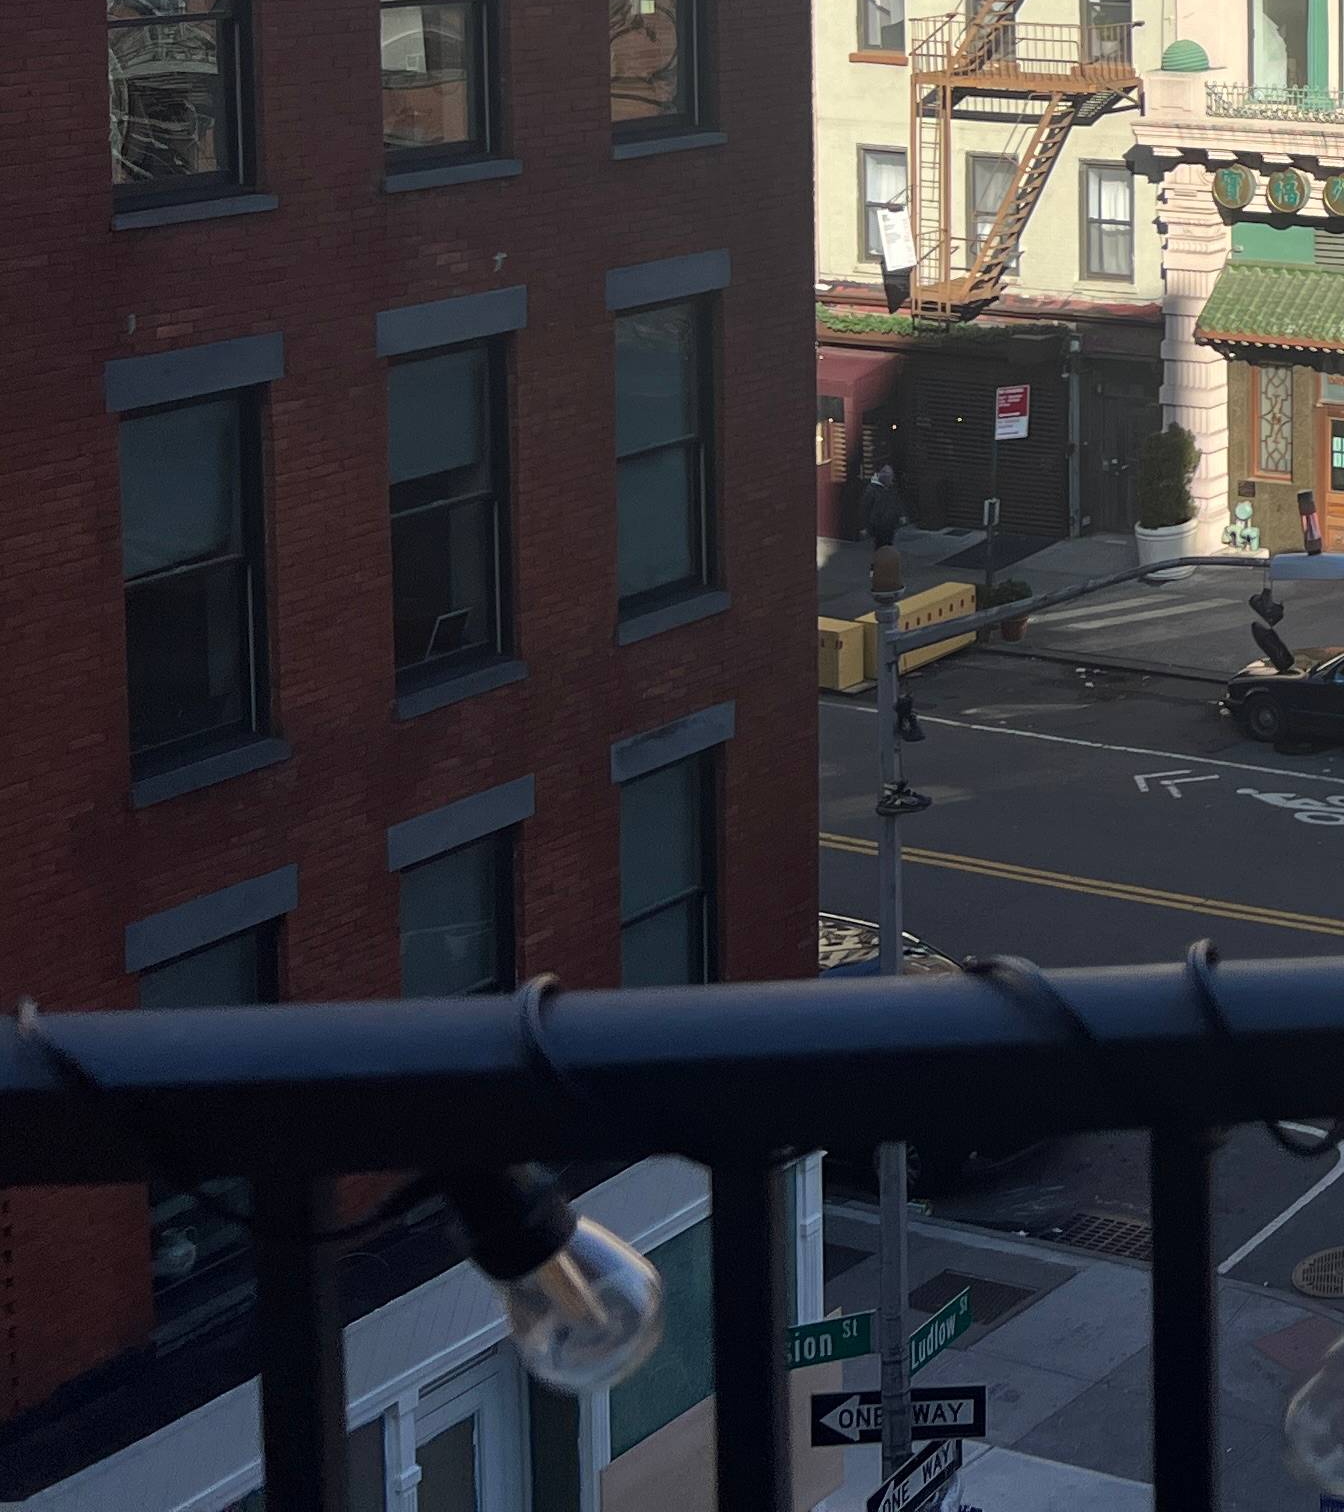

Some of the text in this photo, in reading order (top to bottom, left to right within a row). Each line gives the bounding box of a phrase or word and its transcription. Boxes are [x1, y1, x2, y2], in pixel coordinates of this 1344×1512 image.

[842, 1319, 858, 1339] St
[911, 1295, 968, 1370] Ludlow St
[838, 1401, 963, 1429] ONE WAY
